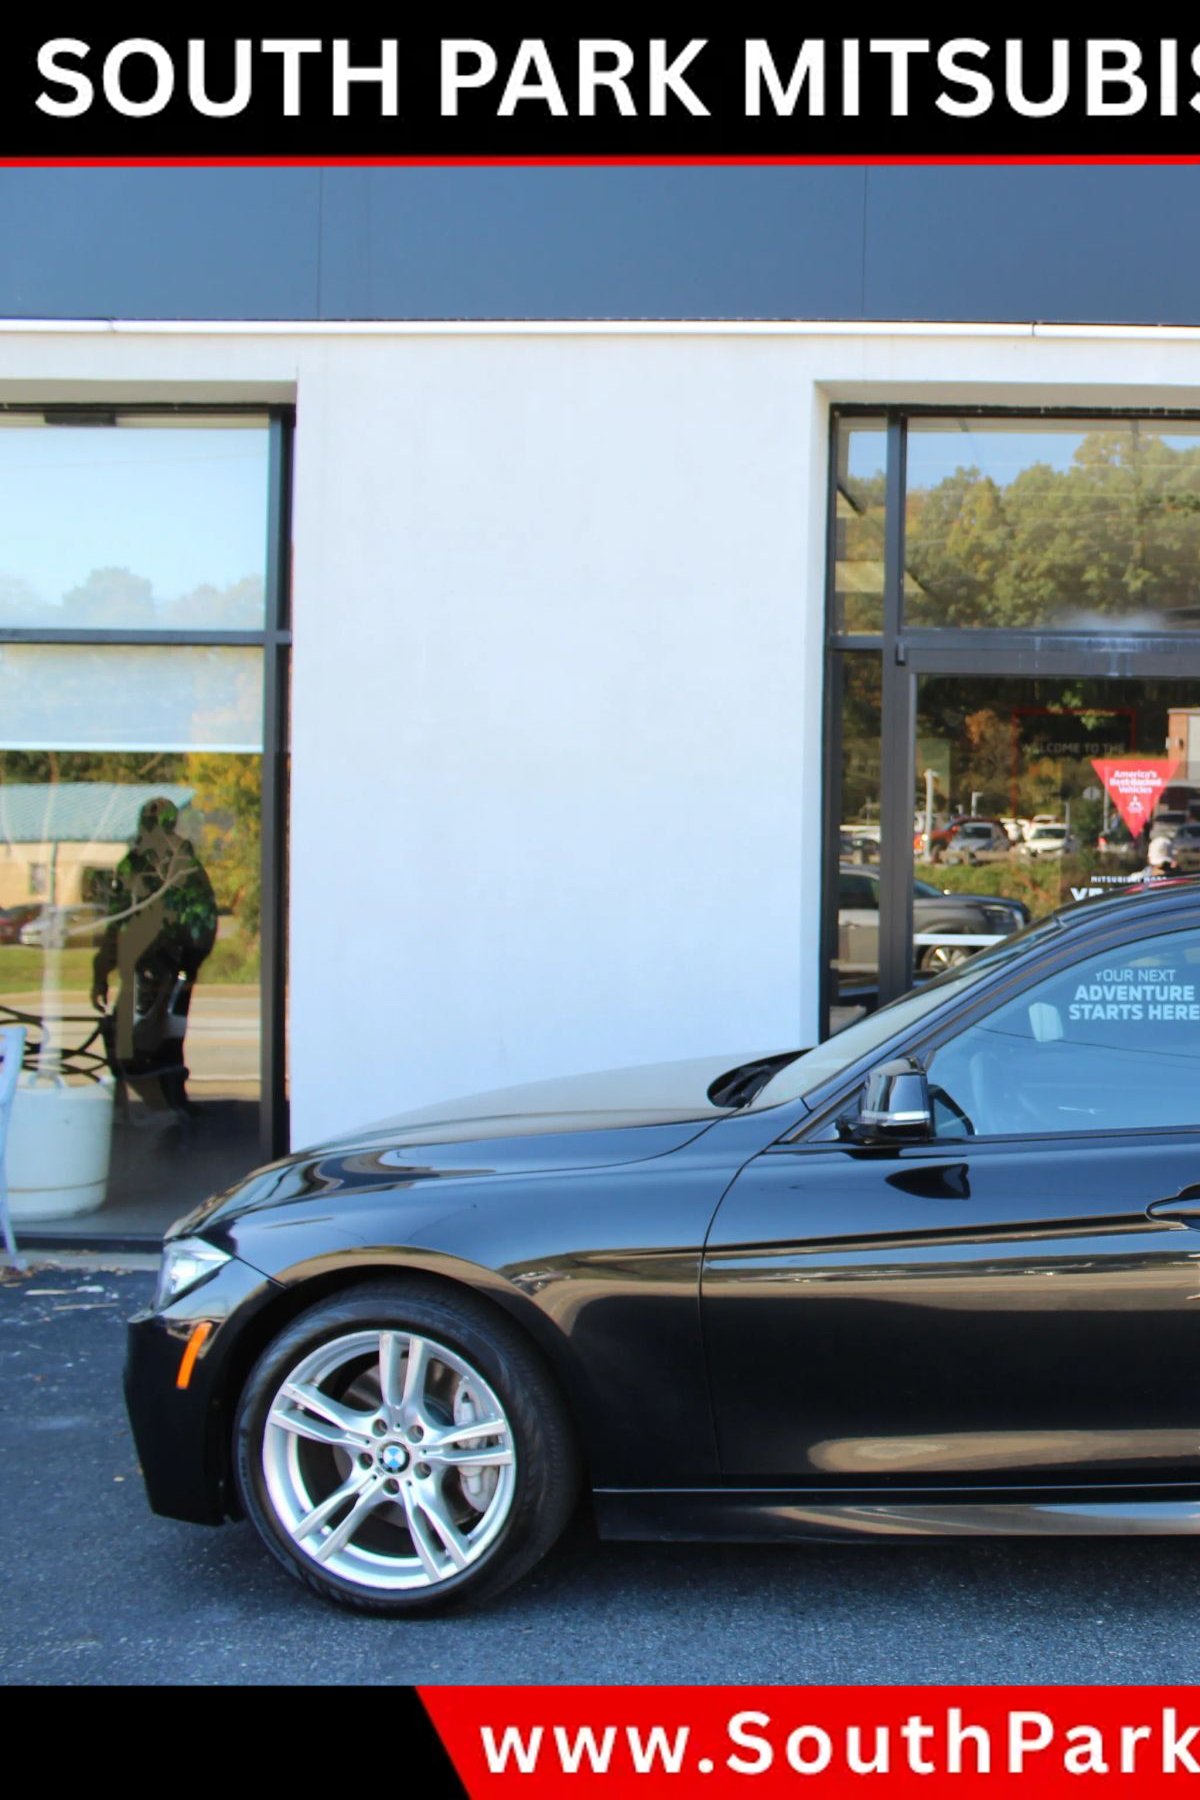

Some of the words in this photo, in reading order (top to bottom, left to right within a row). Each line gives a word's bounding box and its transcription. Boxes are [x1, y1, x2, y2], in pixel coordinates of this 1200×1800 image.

[1095, 969, 1134, 982] YOUR
[1138, 969, 1176, 982] NEXT
[1074, 985, 1195, 1001] ADVENTURE
[1069, 1004, 1143, 1020] STARTS
[1147, 1004, 1200, 1020] HERE
